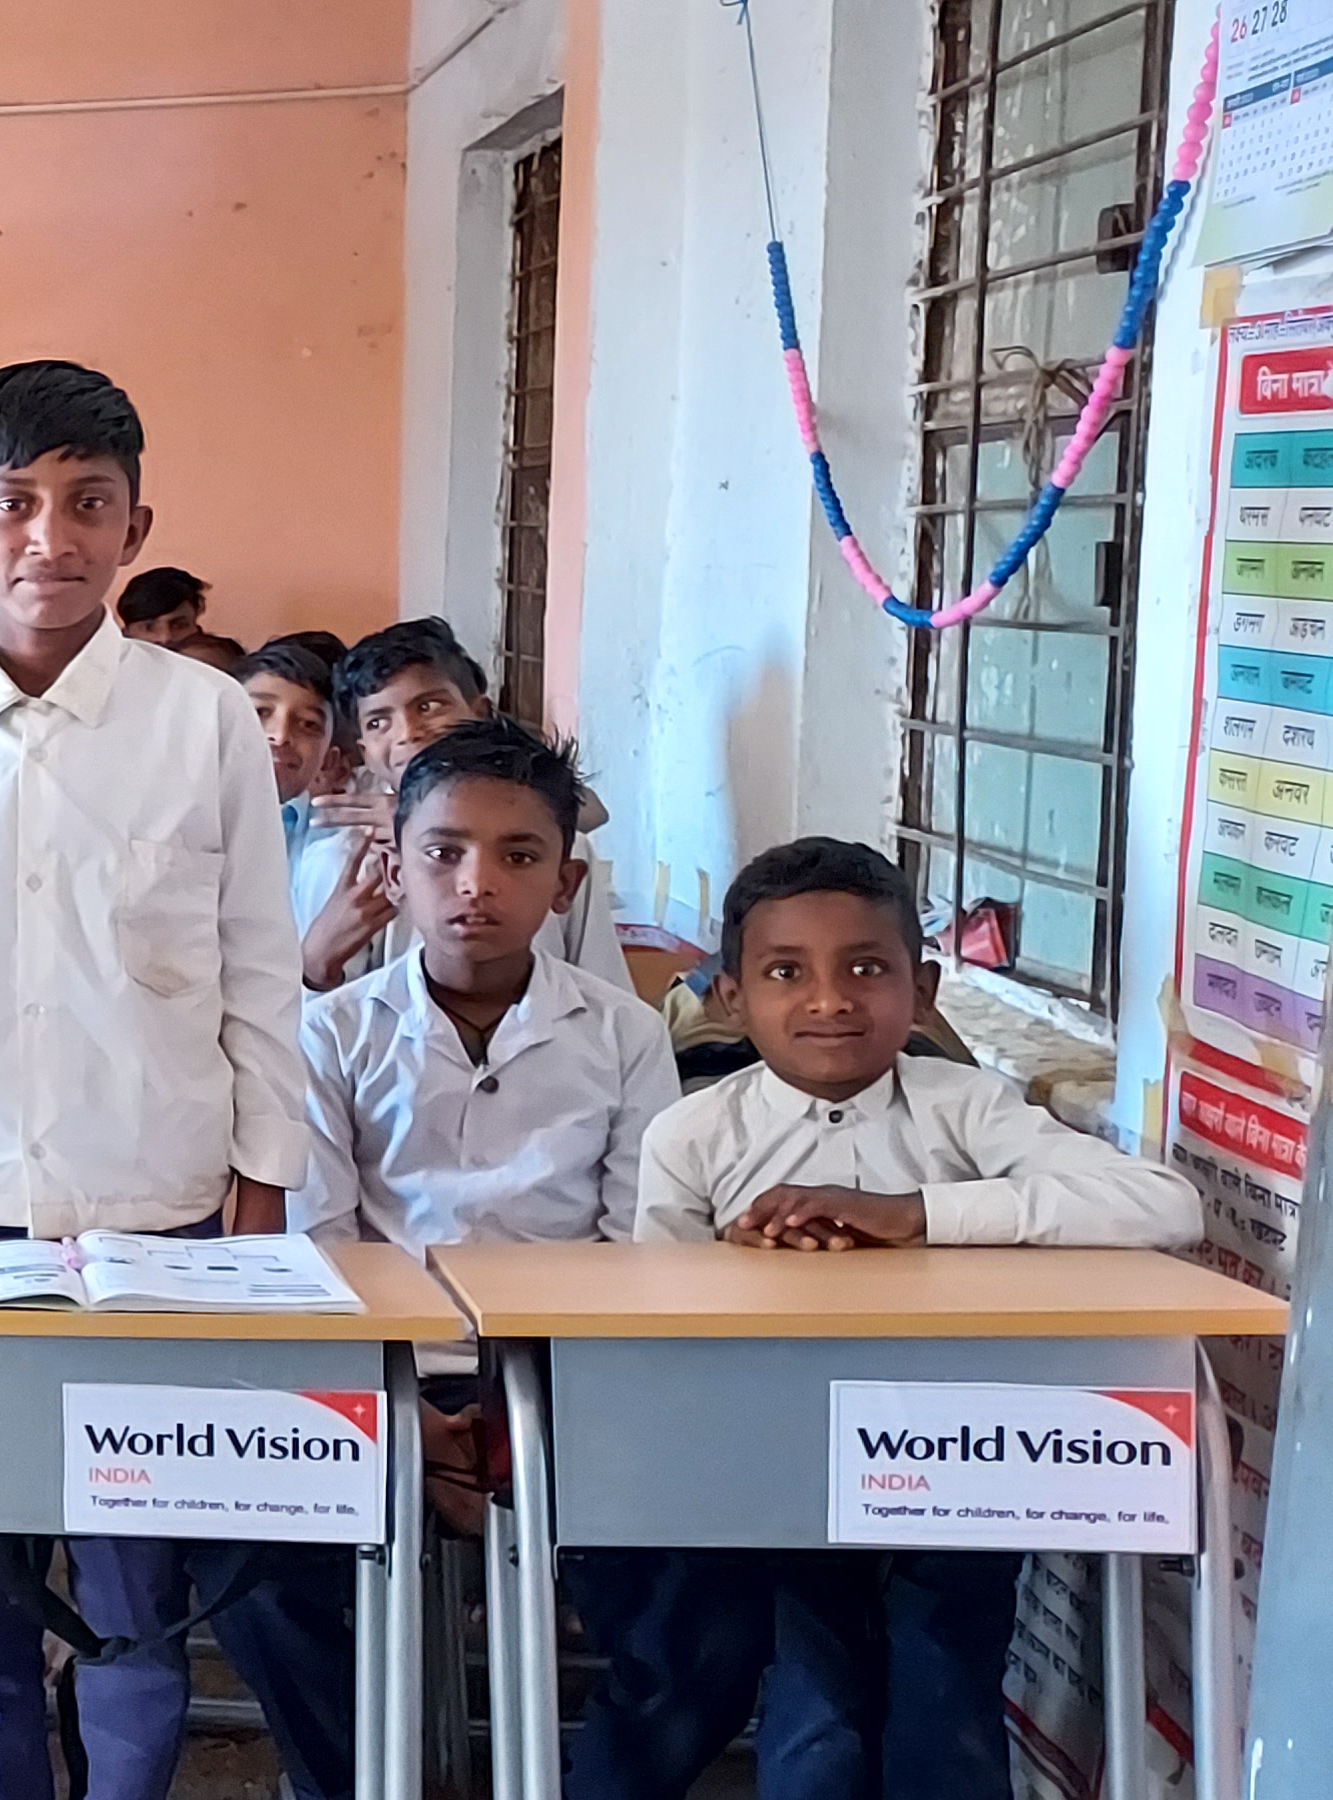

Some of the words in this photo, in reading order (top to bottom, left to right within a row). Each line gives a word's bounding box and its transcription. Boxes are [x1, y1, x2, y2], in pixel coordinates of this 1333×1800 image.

[1230, 14, 1248, 43] 26
[1251, 5, 1268, 36] 27
[1271, 0, 1288, 28] 28
[1257, 365, 1290, 401] बिना
[1272, 779, 1310, 805] अनवर
[1264, 831, 1299, 857] करवट
[1246, 1114, 1271, 1153] बिना
[1245, 1173, 1271, 1209] बिना
[1274, 1193, 1301, 1220] मात्र
[84, 1423, 215, 1457] World
[225, 1429, 360, 1462] Vision
[857, 1426, 1005, 1462] World
[1016, 1429, 1172, 1466] Vision
[88, 1467, 151, 1485] INDIA
[861, 1474, 931, 1491] INDIA
[90, 1494, 147, 1510] Together
[152, 1496, 170, 1508] for
[234, 1499, 252, 1511] for
[314, 1502, 331, 1514] for
[862, 1503, 927, 1518] Together
[932, 1505, 951, 1517] for
[1026, 1508, 1045, 1520] for
[1117, 1511, 1137, 1522] for
